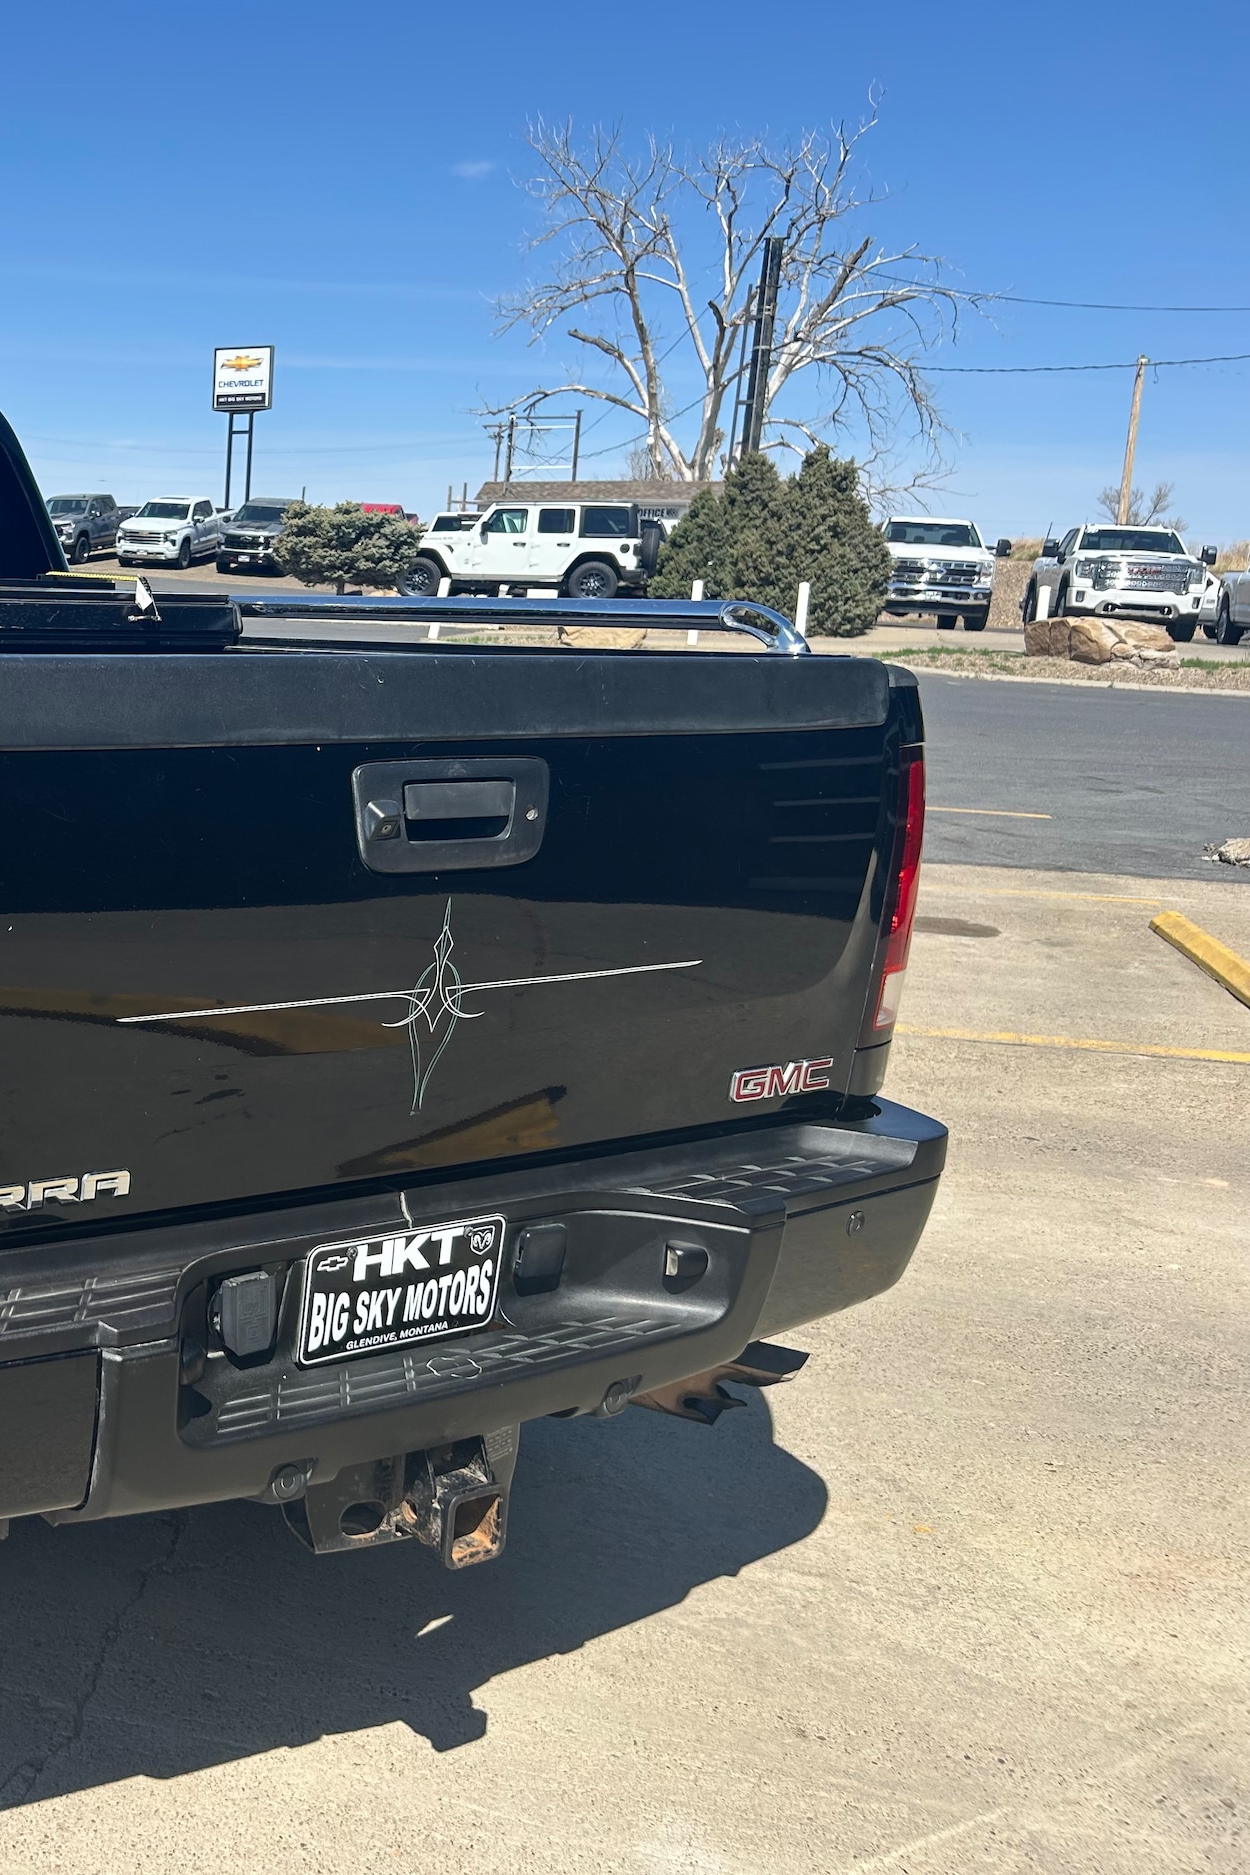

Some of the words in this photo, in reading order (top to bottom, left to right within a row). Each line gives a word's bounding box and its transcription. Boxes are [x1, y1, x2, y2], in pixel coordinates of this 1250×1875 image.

[218, 379, 264, 388] CHEVROLET
[729, 1056, 834, 1102] GMC
[353, 1227, 465, 1281] HKT
[308, 1292, 351, 1352] BIG
[353, 1287, 402, 1334] SKY
[402, 1258, 493, 1322] MOTORS
[346, 1331, 398, 1350] GLENDIVE,
[399, 1321, 449, 1339] MONTANA
